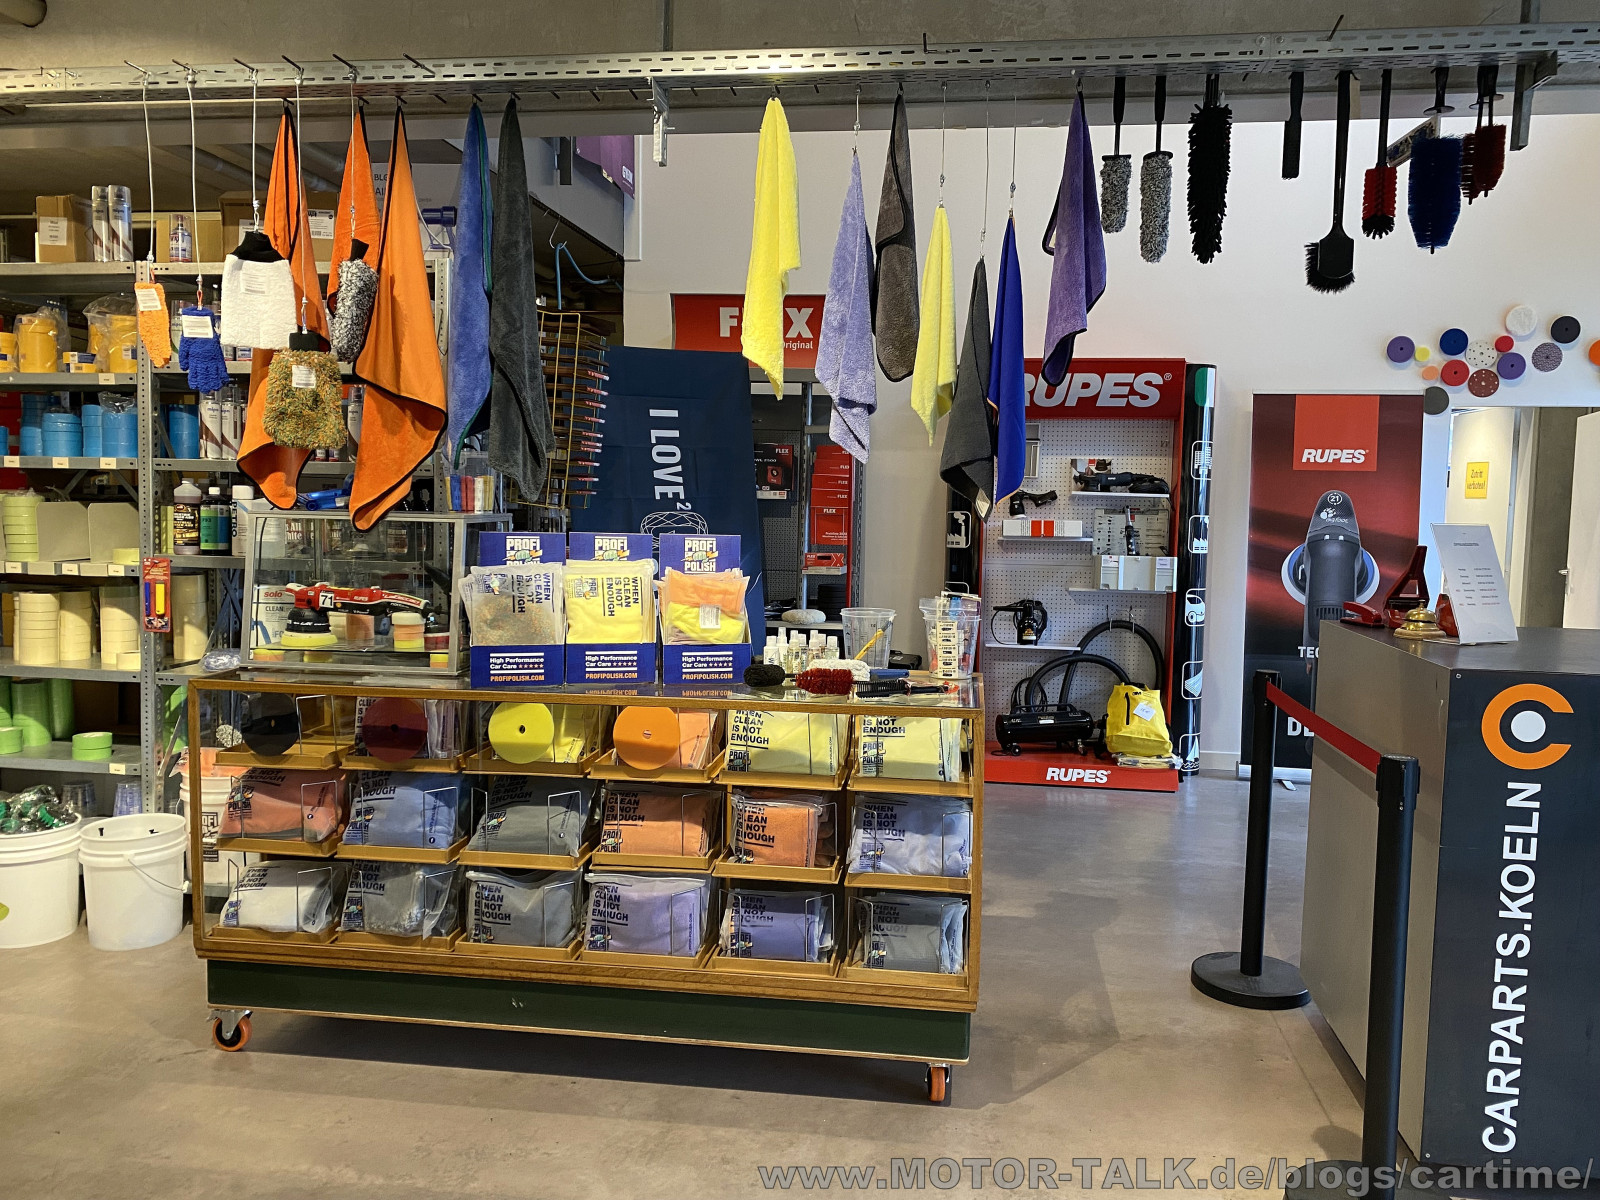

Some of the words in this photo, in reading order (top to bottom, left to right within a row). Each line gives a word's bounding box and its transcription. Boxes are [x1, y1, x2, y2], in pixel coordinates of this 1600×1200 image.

[719, 306, 814, 338] FX
[649, 409, 678, 418] I
[1301, 448, 1366, 464] RUPES
[506, 538, 540, 550] PROFI
[595, 538, 628, 550] PROFI
[685, 540, 717, 551] PROFI
[685, 561, 717, 572] POLISH
[543, 572, 551, 601] WHEN
[614, 577, 622, 586] IS
[264, 590, 283, 598] solo
[622, 577, 631, 608] CLEAN
[630, 576, 639, 605] WHEN
[320, 594, 333, 607] 71
[605, 577, 615, 617] ENOUGH
[614, 586, 623, 608] NOT
[490, 674, 545, 682] PROFIPOLISH.COM
[734, 716, 764, 726] CLEAN
[877, 718, 896, 726] NOT
[732, 724, 740, 732] IS
[742, 726, 762, 735] NOT
[731, 733, 770, 745] ENOUGH
[1046, 767, 1107, 783] RUPES
[608, 797, 640, 806] CLEAN
[607, 805, 615, 813] IS
[619, 805, 638, 813] NOT
[606, 814, 645, 822] ENOUGH
[864, 812, 897, 820] CLEAN
[746, 823, 767, 833] NOT
[361, 872, 379, 881] NOT
[484, 902, 502, 911] NOT
[592, 909, 629, 921] ENOUGH
[1482, 781, 1542, 1153] CARPARTS.KOELN
